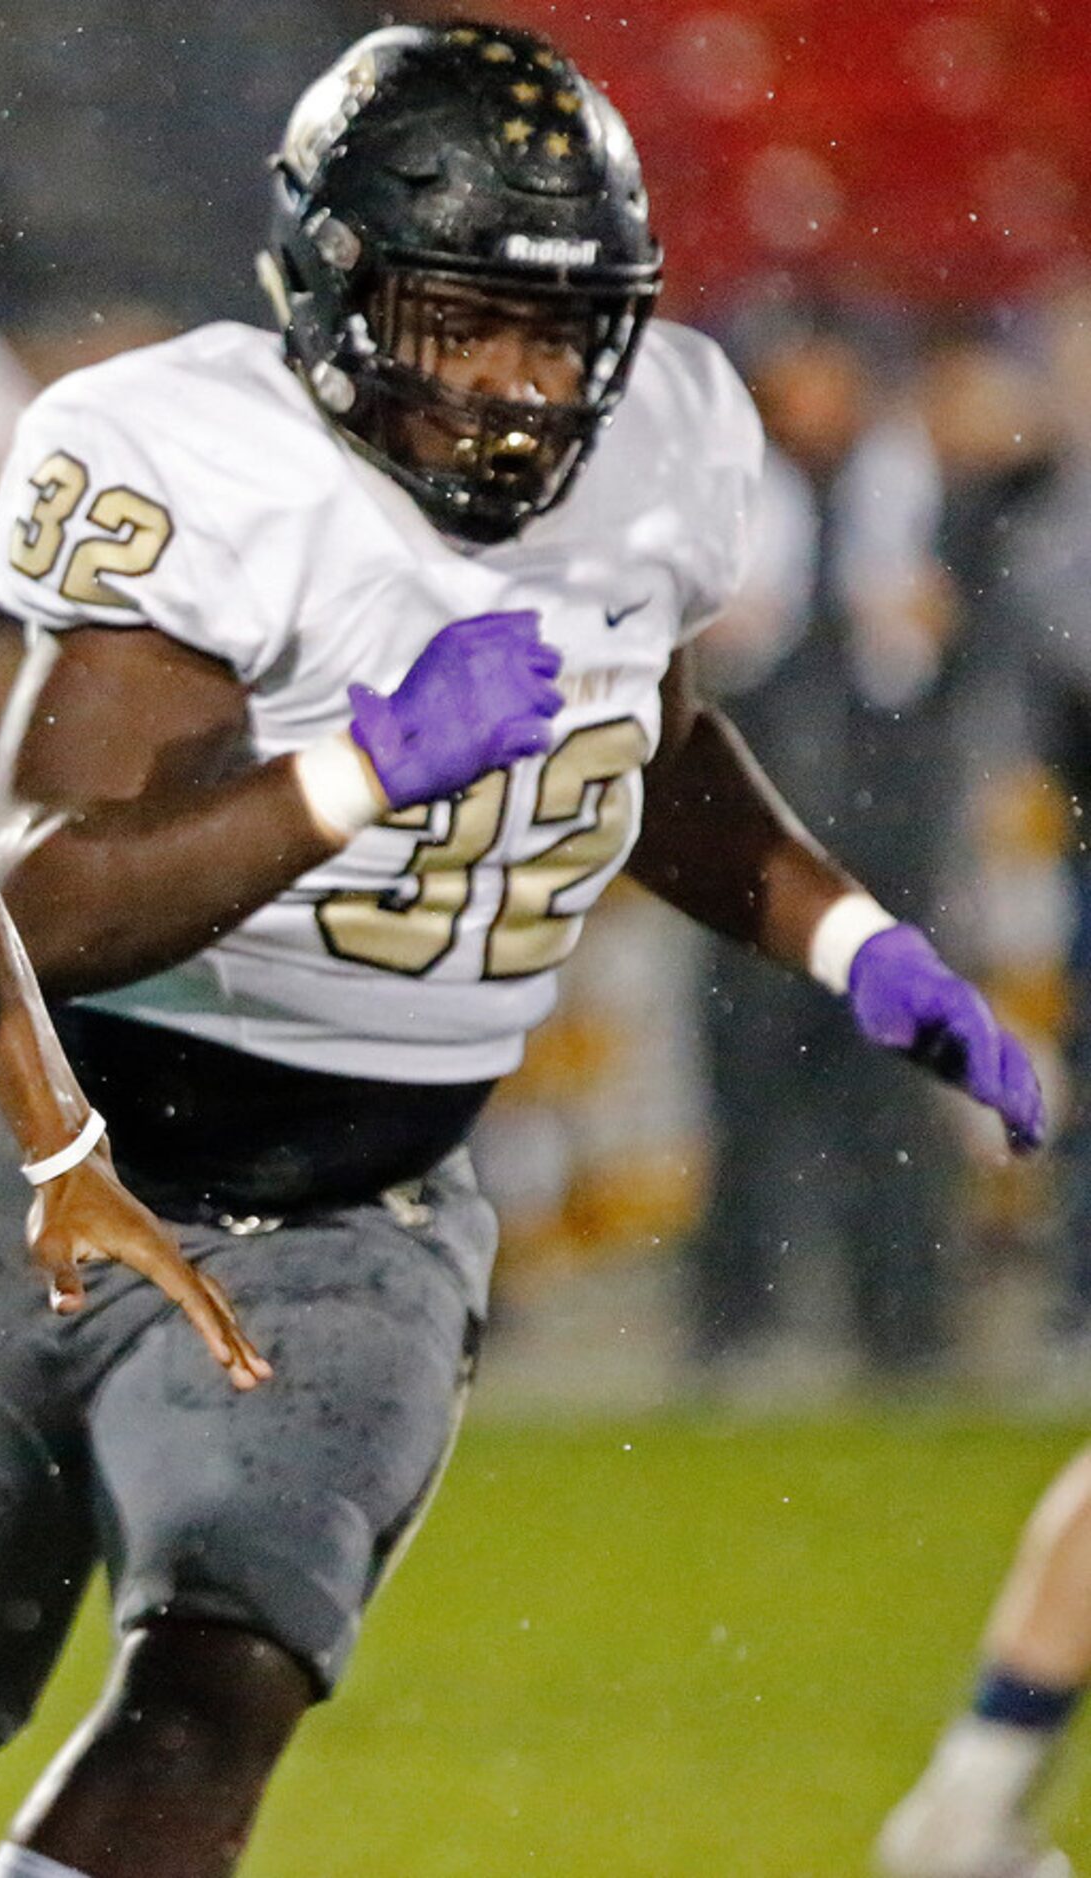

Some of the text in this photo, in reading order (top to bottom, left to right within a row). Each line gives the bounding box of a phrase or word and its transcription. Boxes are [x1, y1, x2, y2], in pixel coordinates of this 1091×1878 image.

[505, 233, 599, 267] Riddell
[9, 448, 175, 607] 32
[315, 715, 651, 982] 32
